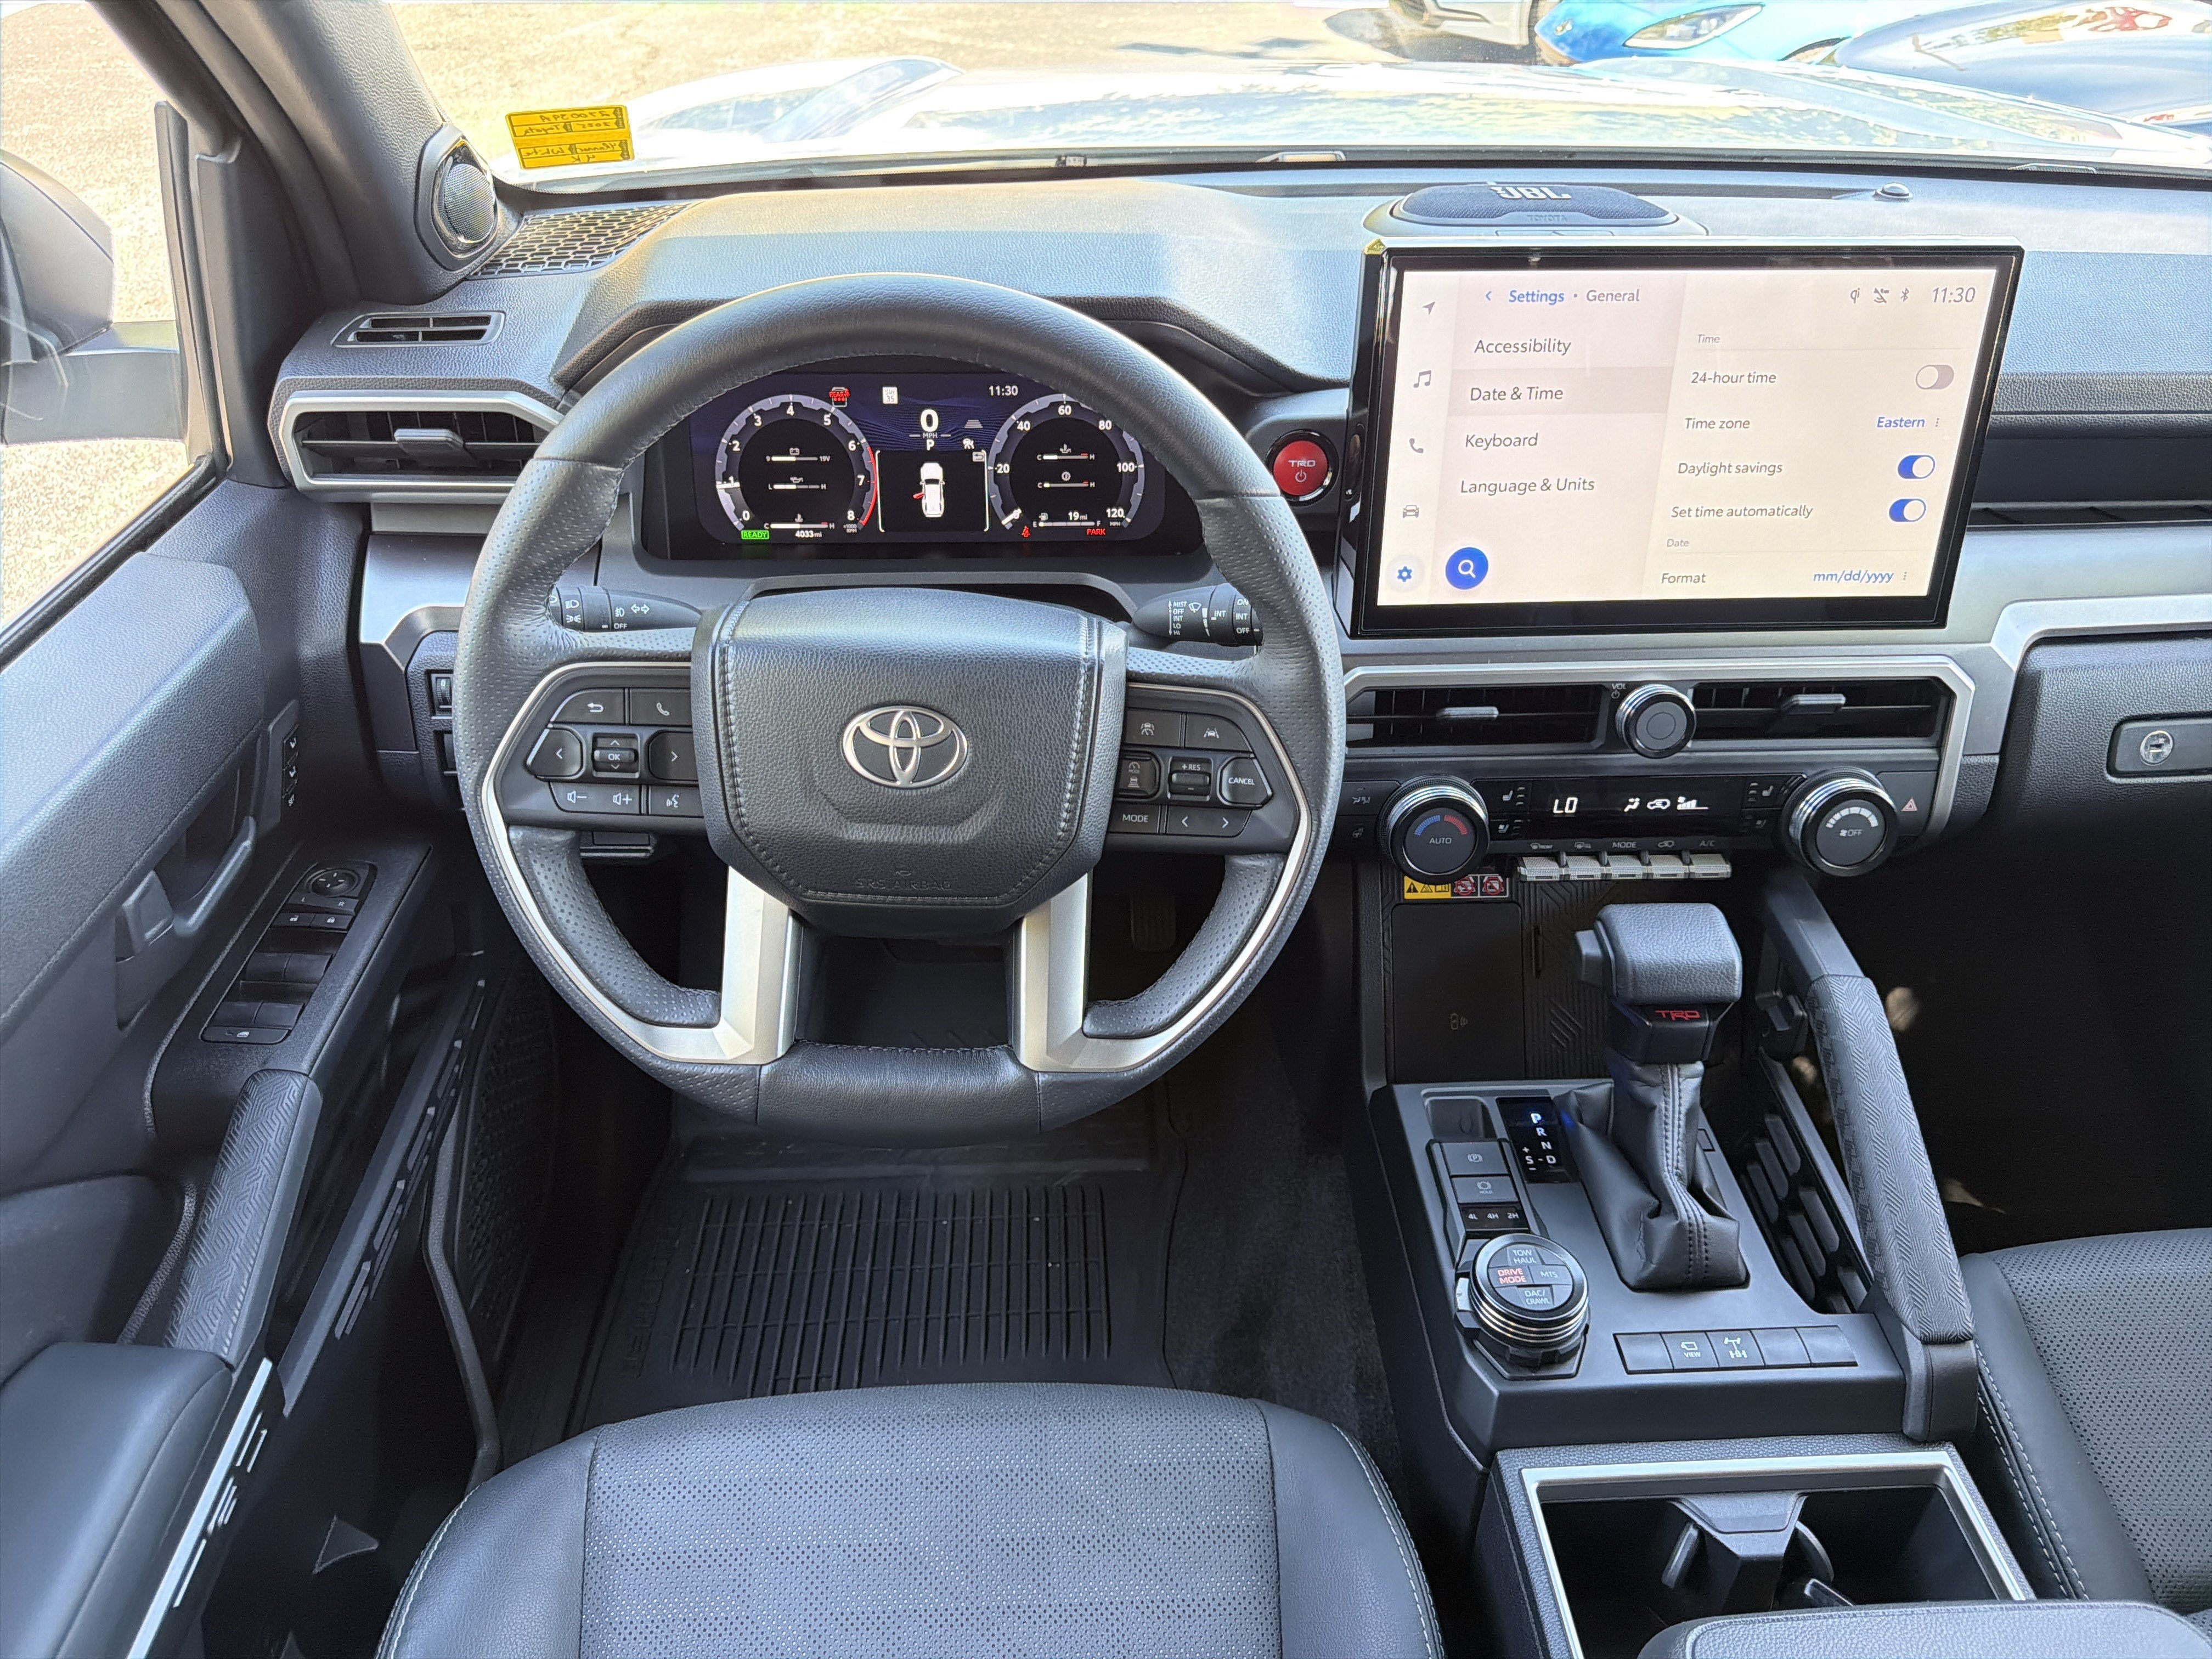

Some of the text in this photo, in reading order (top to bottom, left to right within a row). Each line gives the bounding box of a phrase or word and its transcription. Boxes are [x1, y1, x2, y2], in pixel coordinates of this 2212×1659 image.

[1498, 187, 1572, 200] JBL
[1527, 214, 1567, 222] TOYOTA
[1508, 289, 1640, 306] Settings General
[1932, 286, 1976, 303] 11:30
[1697, 334, 1720, 343] Time
[1474, 338, 1572, 356] Accessibility
[1691, 371, 1777, 384] 24-hour time
[989, 385, 1019, 397] 11:30
[1470, 386, 1564, 401] Date & Time
[786, 405, 795, 416] 4
[1058, 405, 1072, 416] 60
[754, 415, 762, 426] 3
[823, 415, 832, 426] 5
[920, 409, 939, 432] 0
[1018, 421, 1031, 431] 40
[1098, 420, 1112, 431] 80
[1684, 417, 1751, 430] Time zone
[1876, 416, 1926, 428] Eastern
[732, 441, 741, 452] 2
[848, 440, 857, 451] 6
[926, 439, 935, 450] P
[1465, 432, 1538, 451] Keyboard
[996, 463, 1010, 473] 20
[1116, 462, 1135, 473] 100
[1288, 460, 1316, 468] TRD
[1678, 461, 1783, 477] Daylight savings
[856, 475, 865, 486] 7
[1460, 477, 1595, 496] Language & Units
[742, 510, 751, 521] 0
[847, 510, 855, 521] 8
[1106, 508, 1124, 518] 120
[1671, 504, 1814, 519] Set time automatically
[1667, 538, 1690, 548] Date
[1661, 573, 1707, 584] Format
[1813, 569, 1895, 584] mm/dd/yyyy
[608, 753, 621, 761] OK
[1228, 777, 1255, 786] CANCEL
[1122, 814, 1149, 823] MODE
[856, 879, 952, 890] SRS AIRBAG
[1654, 1010, 1701, 1020] TRD
[1530, 1113, 1543, 1124] P
[1536, 1127, 1547, 1137] R
[1541, 1141, 1553, 1150] N
[1497, 1268, 1523, 1277] DRIVE
[1499, 1276, 1527, 1284] MODE
